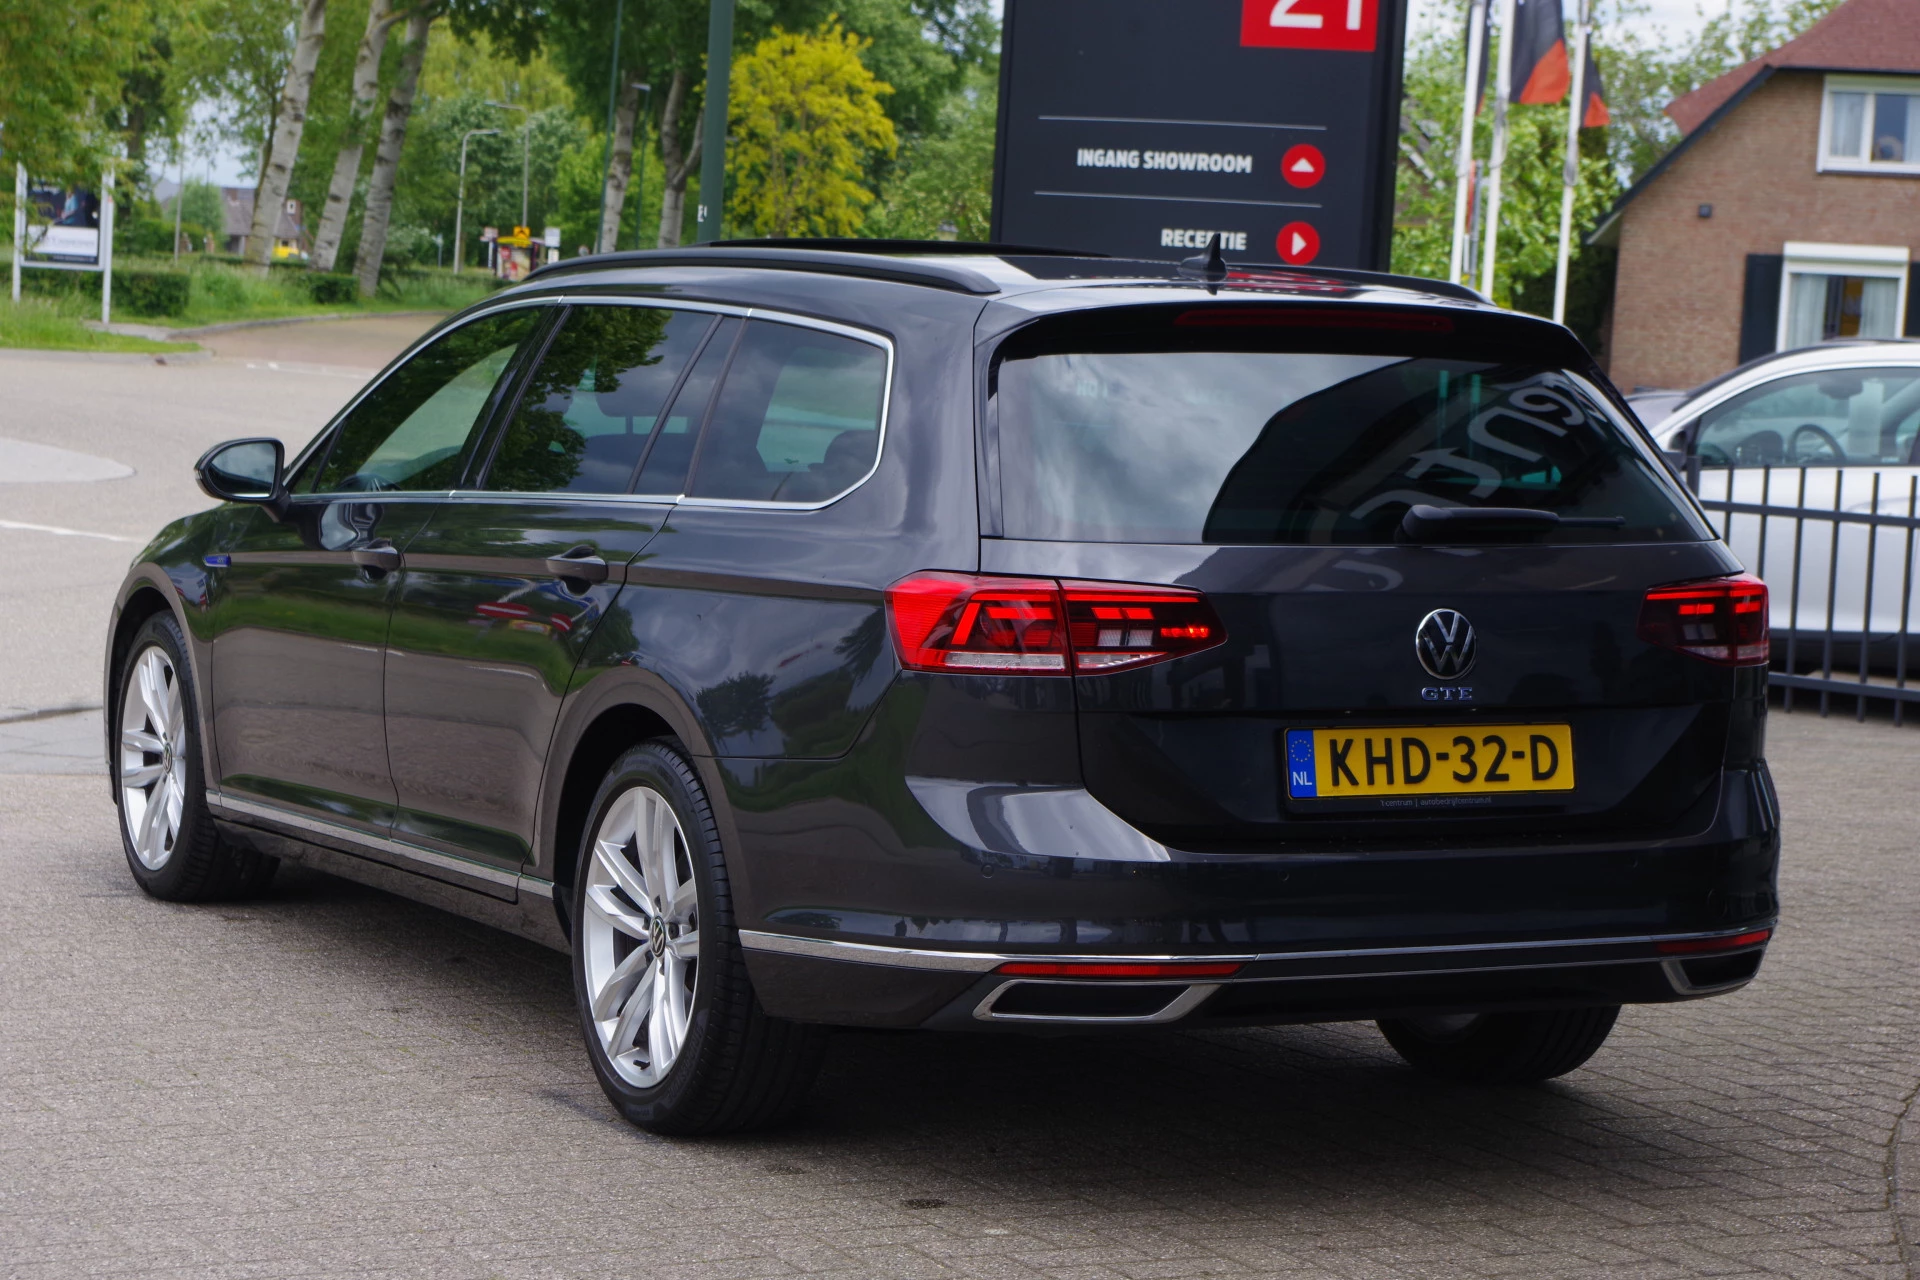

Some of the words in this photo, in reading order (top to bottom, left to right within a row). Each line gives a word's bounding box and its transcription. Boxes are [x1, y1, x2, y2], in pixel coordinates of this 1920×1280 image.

[1077, 148, 1140, 168] INGANG
[1142, 151, 1253, 173] SHOWROOM
[1421, 686, 1474, 701] GTE
[1329, 734, 1559, 787] KHD-32-D
[1292, 771, 1313, 786] NL
